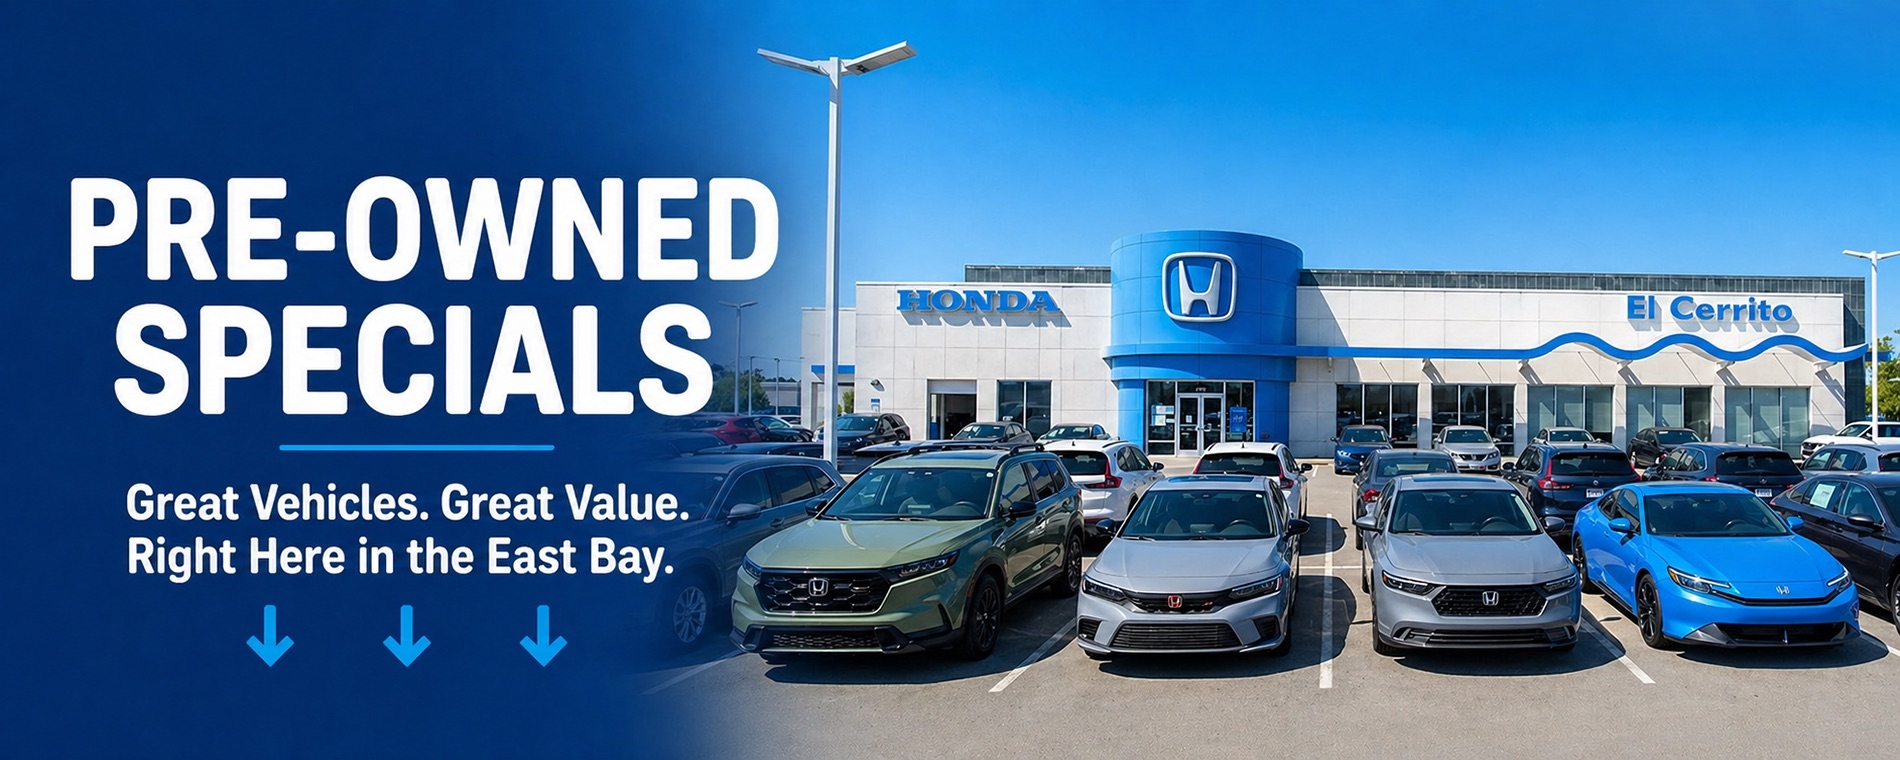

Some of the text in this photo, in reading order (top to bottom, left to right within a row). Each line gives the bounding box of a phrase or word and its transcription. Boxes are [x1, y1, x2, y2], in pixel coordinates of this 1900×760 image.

[897, 289, 1060, 313] HONDA
[1627, 295, 1793, 322] El Cerrito
